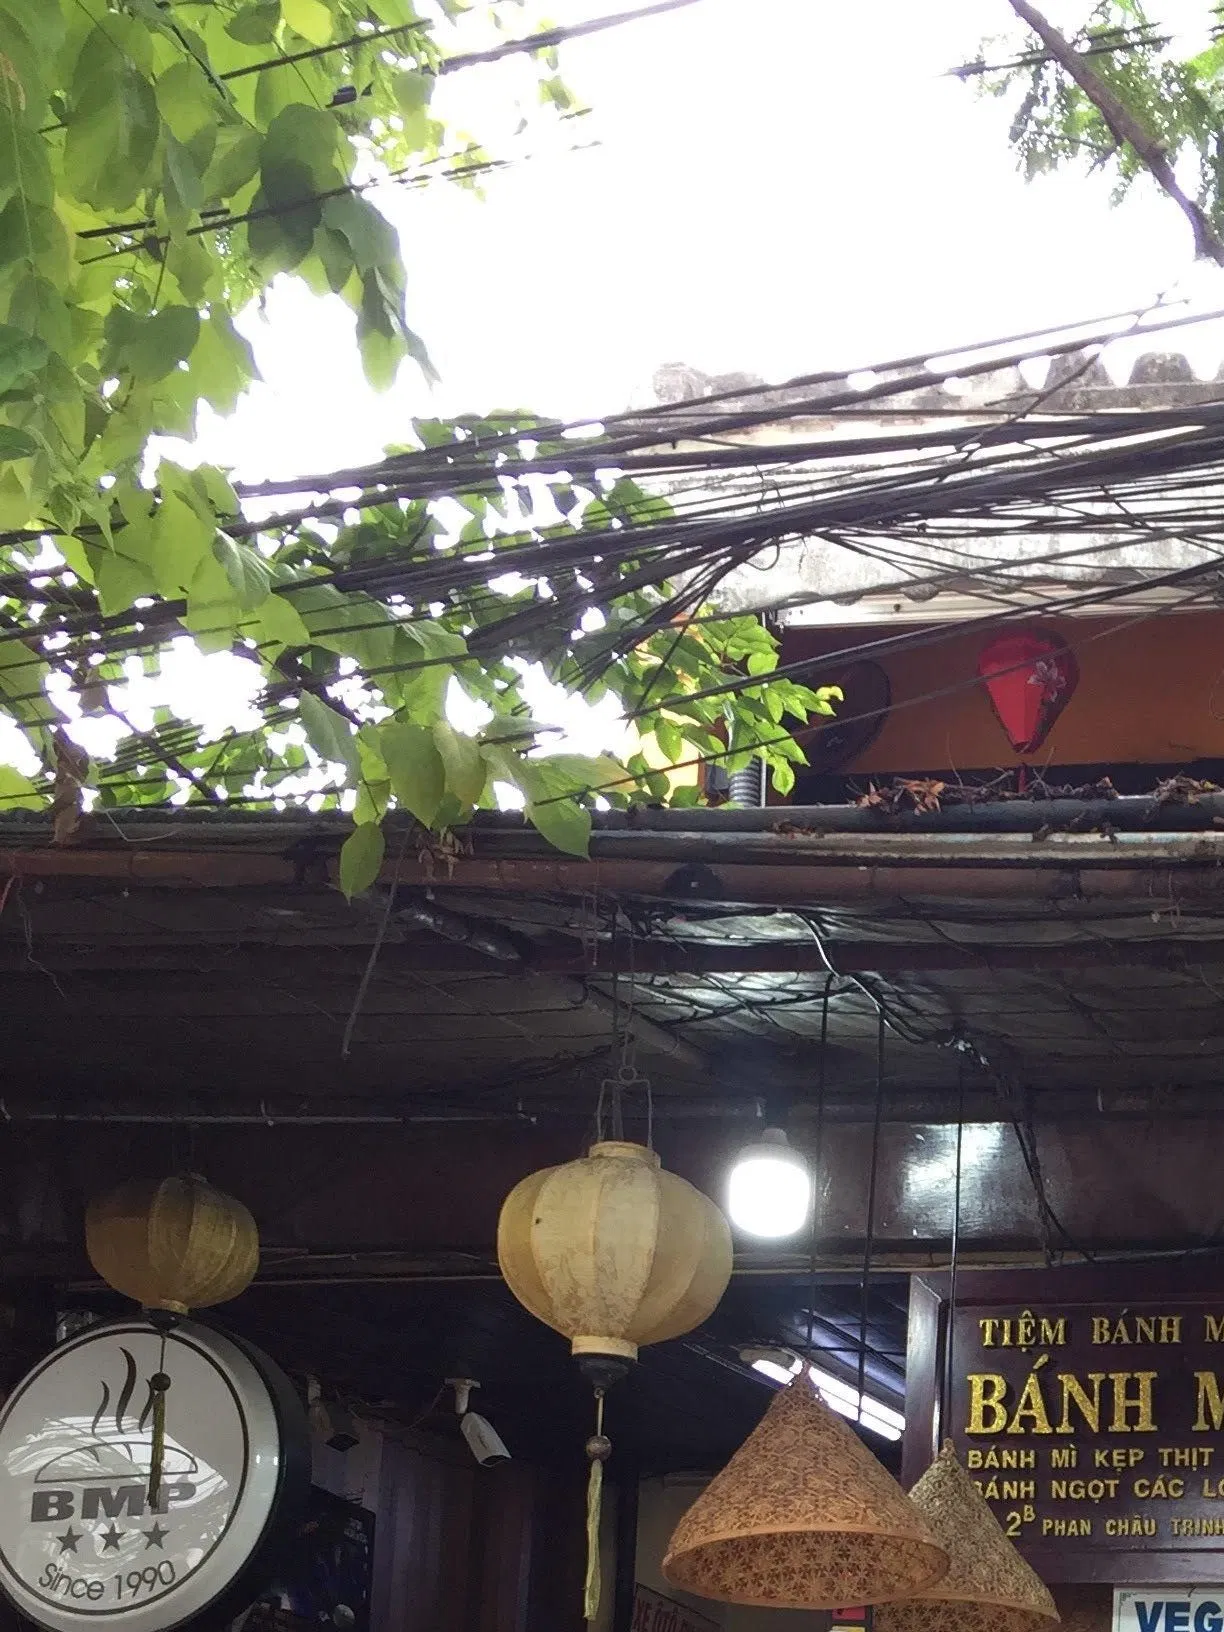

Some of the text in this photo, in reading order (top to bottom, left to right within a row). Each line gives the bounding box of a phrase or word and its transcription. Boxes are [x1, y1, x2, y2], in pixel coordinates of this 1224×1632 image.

[979, 1310, 1066, 1352] TIỆM
[1092, 1308, 1182, 1344] BÁNH
[964, 1353, 1158, 1434] BÁNH
[968, 1446, 1036, 1469] BÁNH
[1051, 1443, 1077, 1468] MÌ
[1095, 1448, 1145, 1473] KẸP
[1159, 1447, 1215, 1473] THỊT
[31, 1482, 197, 1523] BMP
[1051, 1479, 1120, 1504] NGỌT
[1134, 1474, 1185, 1499] CÁC
[1042, 1519, 1092, 1537] PHAN
[38, 1559, 176, 1601] Since 1990
